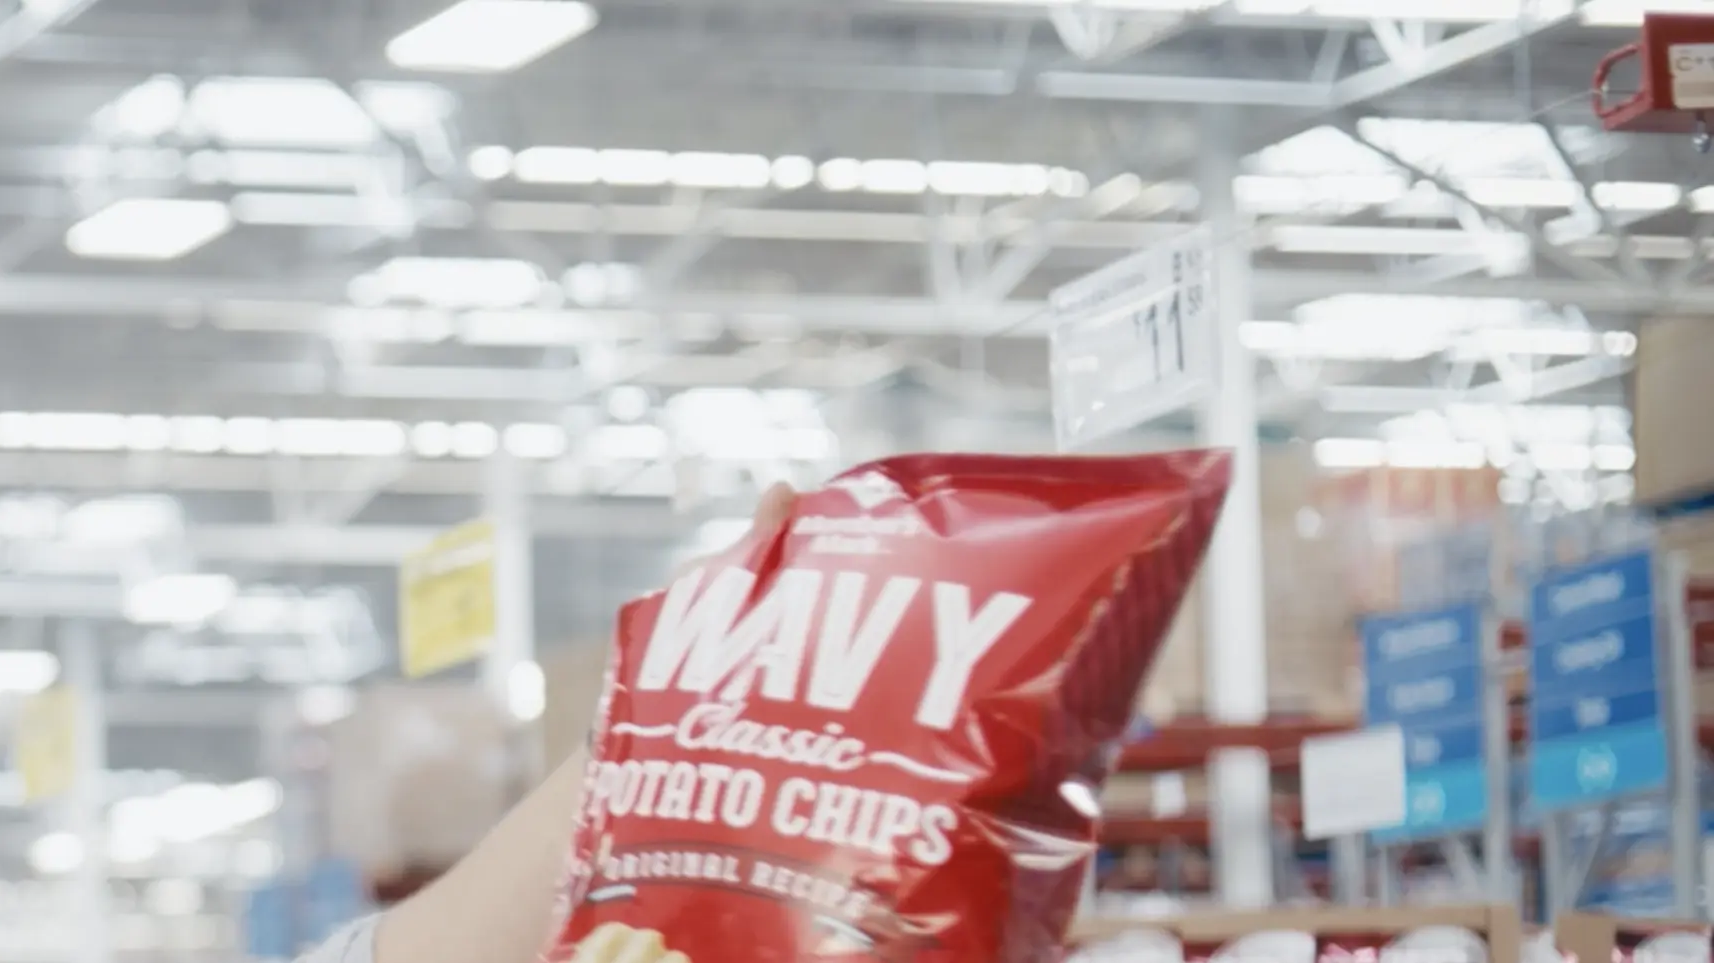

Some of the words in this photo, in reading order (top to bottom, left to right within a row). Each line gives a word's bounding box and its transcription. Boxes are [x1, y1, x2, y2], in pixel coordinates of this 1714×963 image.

[636, 566, 1035, 731] WAVY
[675, 698, 867, 771] Classic
[587, 758, 766, 829] POTATO
[772, 777, 959, 866] CHIPS
[603, 851, 741, 883] ORIGINAL
